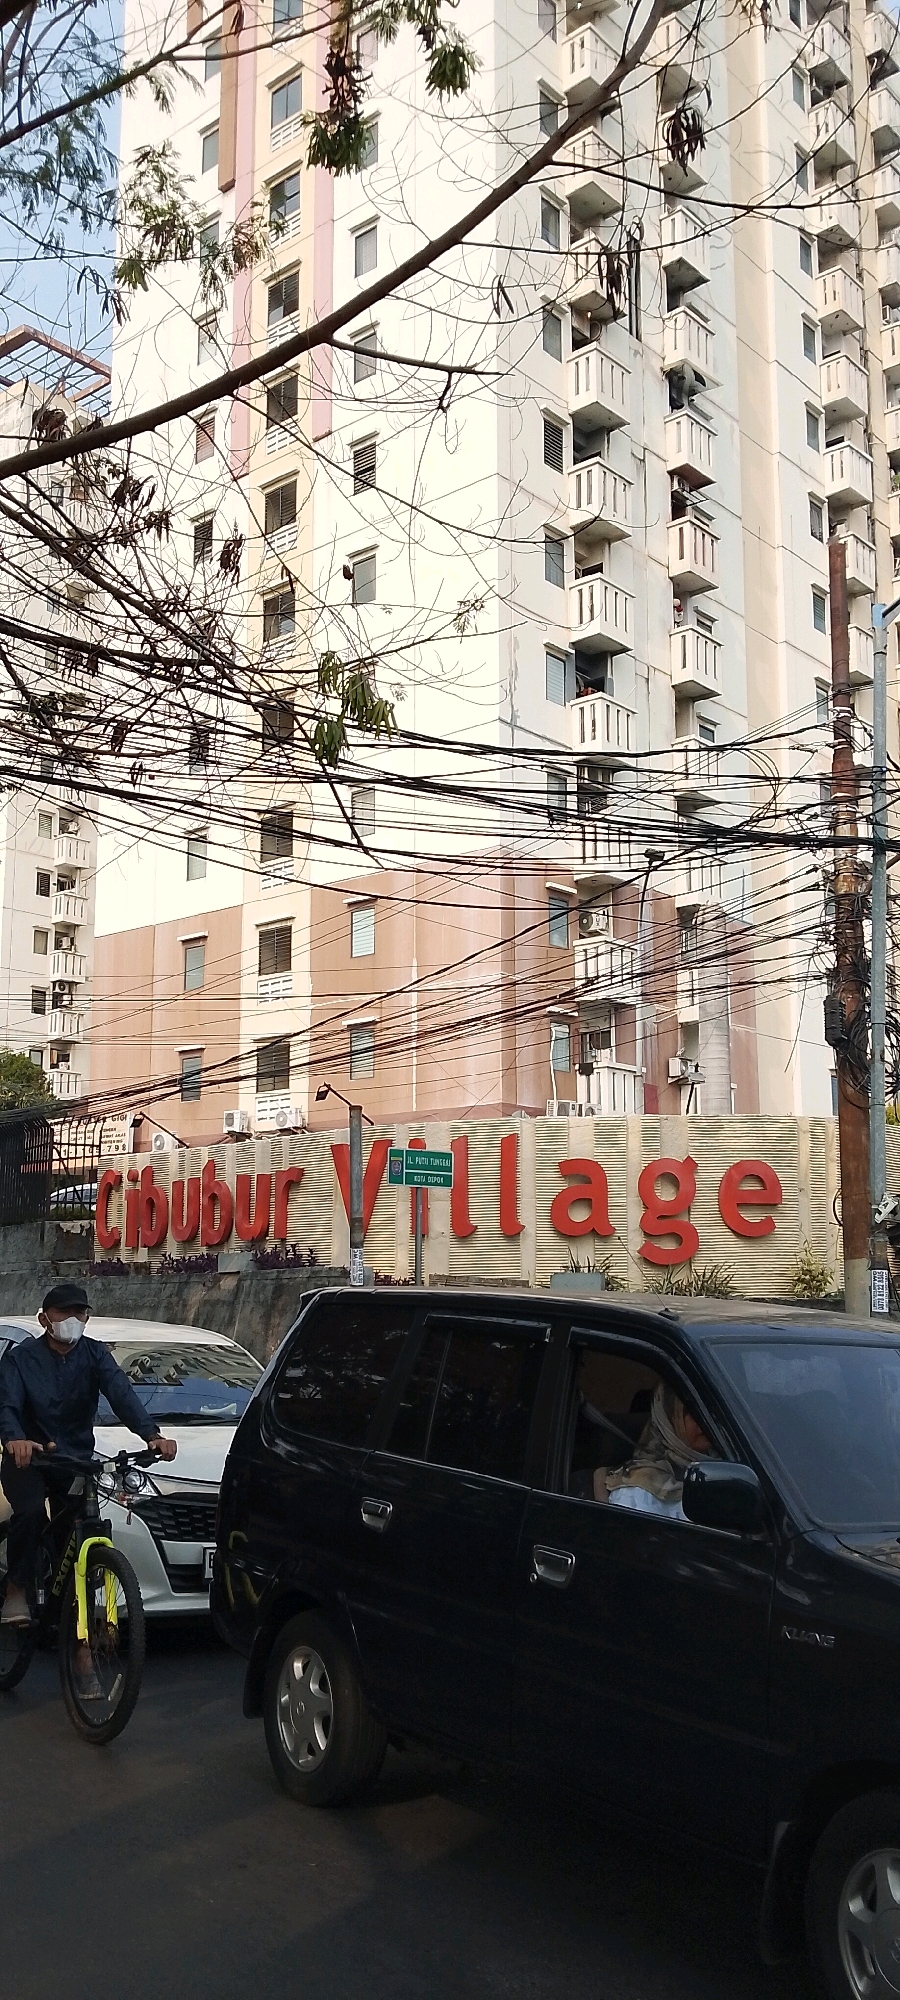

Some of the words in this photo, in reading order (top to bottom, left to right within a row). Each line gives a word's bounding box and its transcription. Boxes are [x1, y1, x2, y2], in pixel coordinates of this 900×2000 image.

[95, 1160, 304, 1249] Cibubur
[330, 1133, 783, 1265] Village
[413, 1175, 426, 1183] KOTA
[427, 1176, 444, 1184] DEPOK
[52, 1530, 76, 1597] EXOTI
